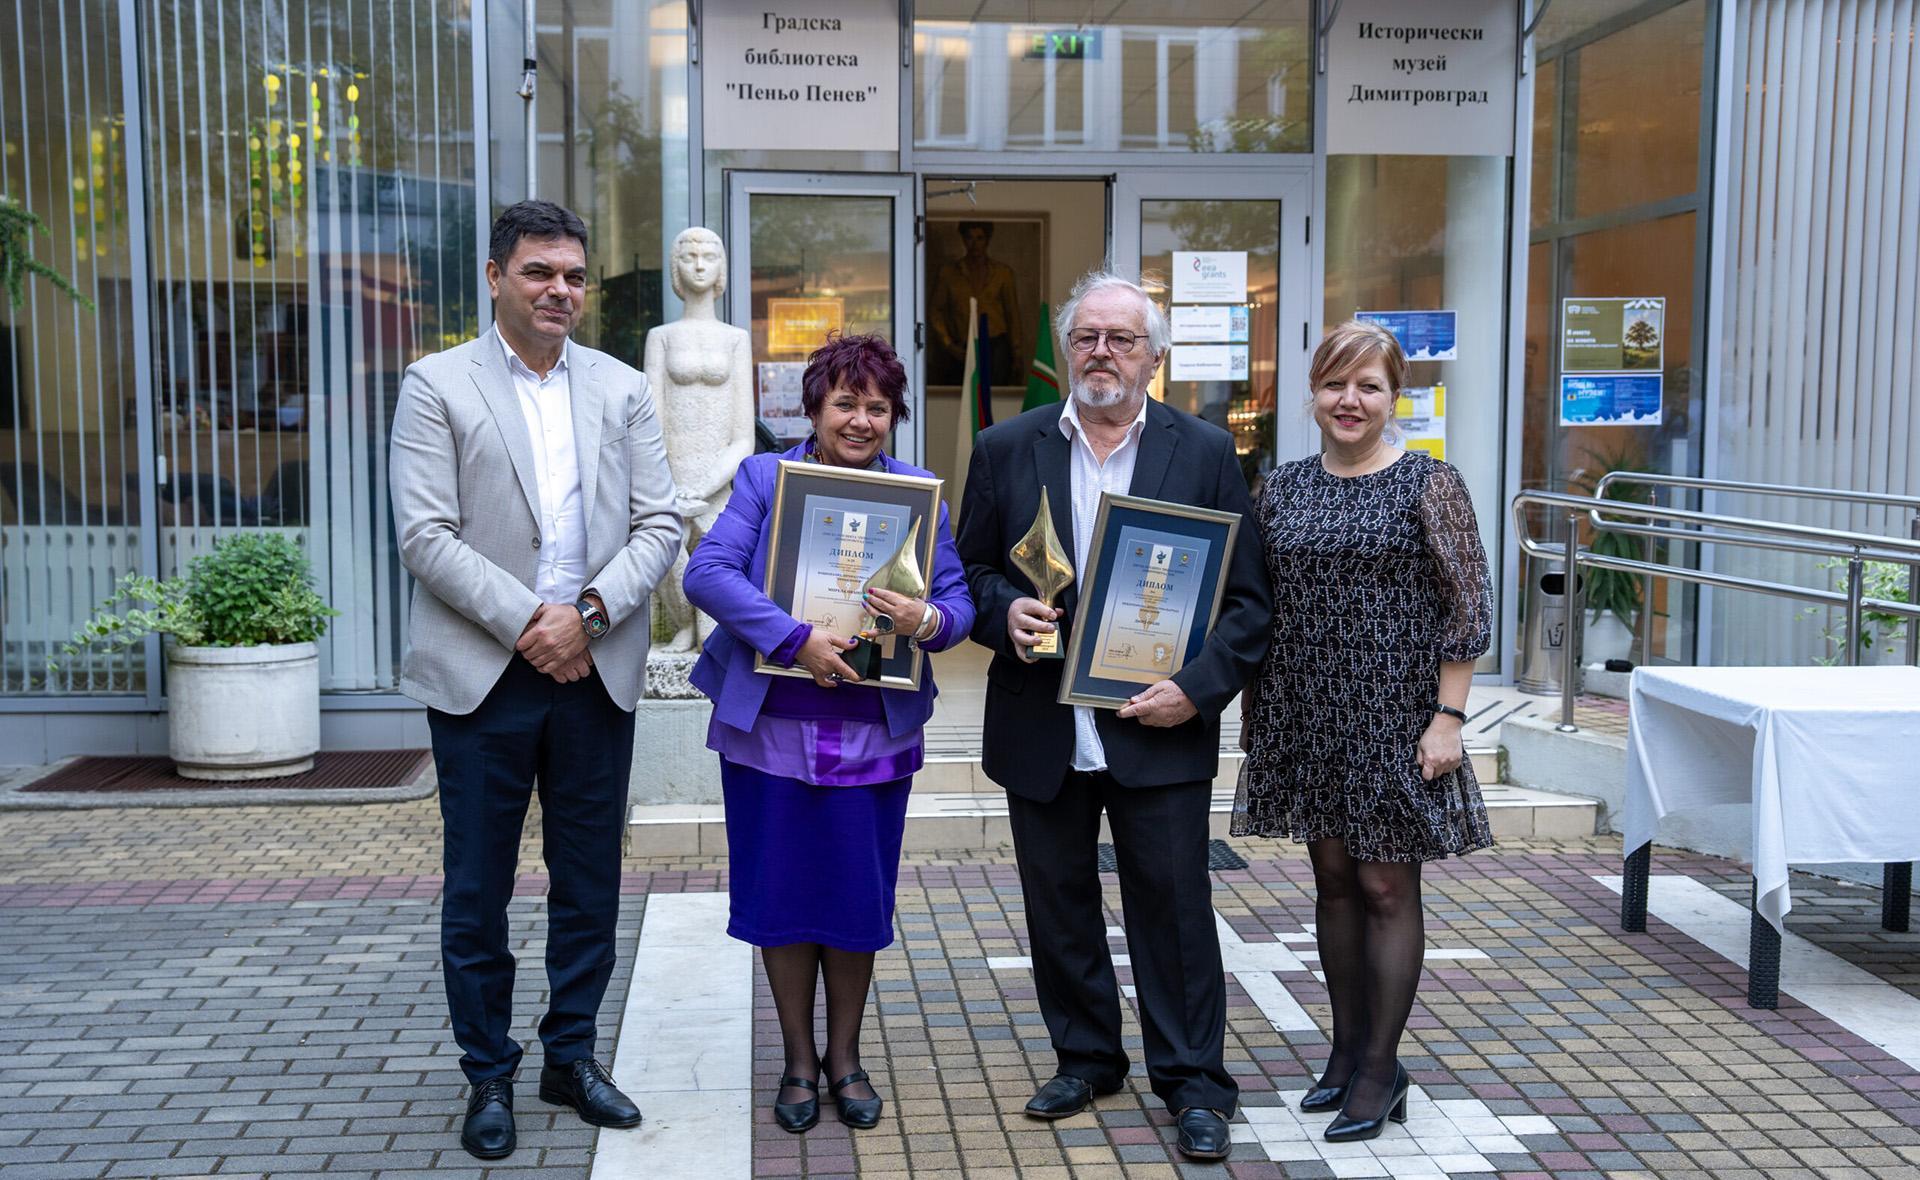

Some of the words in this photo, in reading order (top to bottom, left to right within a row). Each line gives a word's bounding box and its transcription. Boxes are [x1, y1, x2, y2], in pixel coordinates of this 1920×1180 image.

[762, 12, 842, 34] Градска
[1358, 22, 1484, 44] Исторически
[1032, 34, 1095, 54] EXIT
[744, 48, 859, 67] библиотека
[1392, 55, 1447, 74] музей
[726, 83, 799, 101] "Пеньо
[806, 84, 878, 102] Пенев"
[1348, 84, 1489, 106] Димитровград
[1201, 271, 1227, 280] grants
[829, 548, 874, 559] ДИПЛОМ
[1135, 580, 1173, 591] ДИПЛОМ
